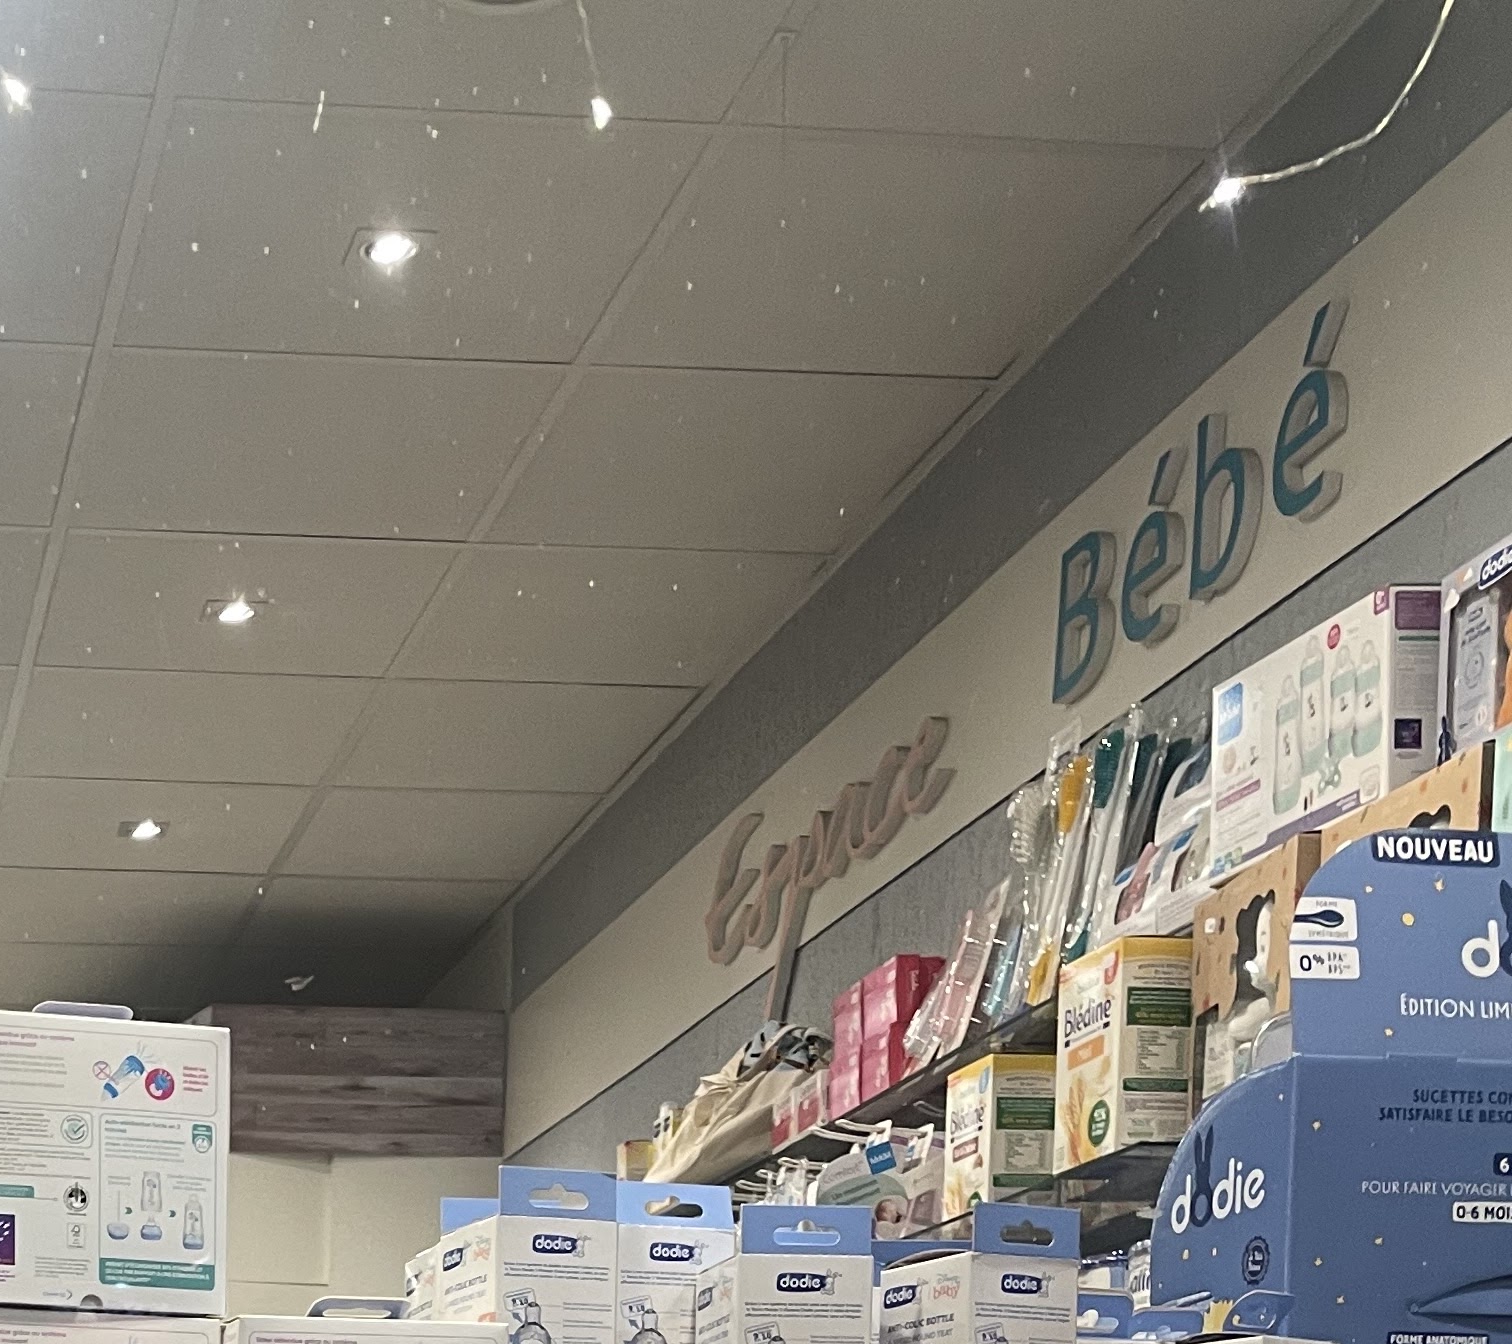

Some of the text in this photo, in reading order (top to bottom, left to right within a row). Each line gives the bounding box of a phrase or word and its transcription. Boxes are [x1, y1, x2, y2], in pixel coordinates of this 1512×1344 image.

[1053, 300, 1350, 706] Bébé
[1377, 836, 1494, 863] NOUVEAU
[1400, 993, 1475, 1018] ÉDITION
[1413, 1089, 1483, 1105] SUCETTES
[1379, 1107, 1452, 1123] SATISFAIRE
[1458, 1109, 1473, 1123] LE
[1361, 1180, 1506, 1197] POUR FAIRE VOYAGER
[1456, 1206, 1479, 1219] 0-6
[535, 1236, 573, 1250] dodie
[652, 1244, 691, 1258] dodie
[780, 1274, 822, 1289] dodie
[1004, 1275, 1039, 1291] dodie
[884, 1286, 914, 1305] dodie
